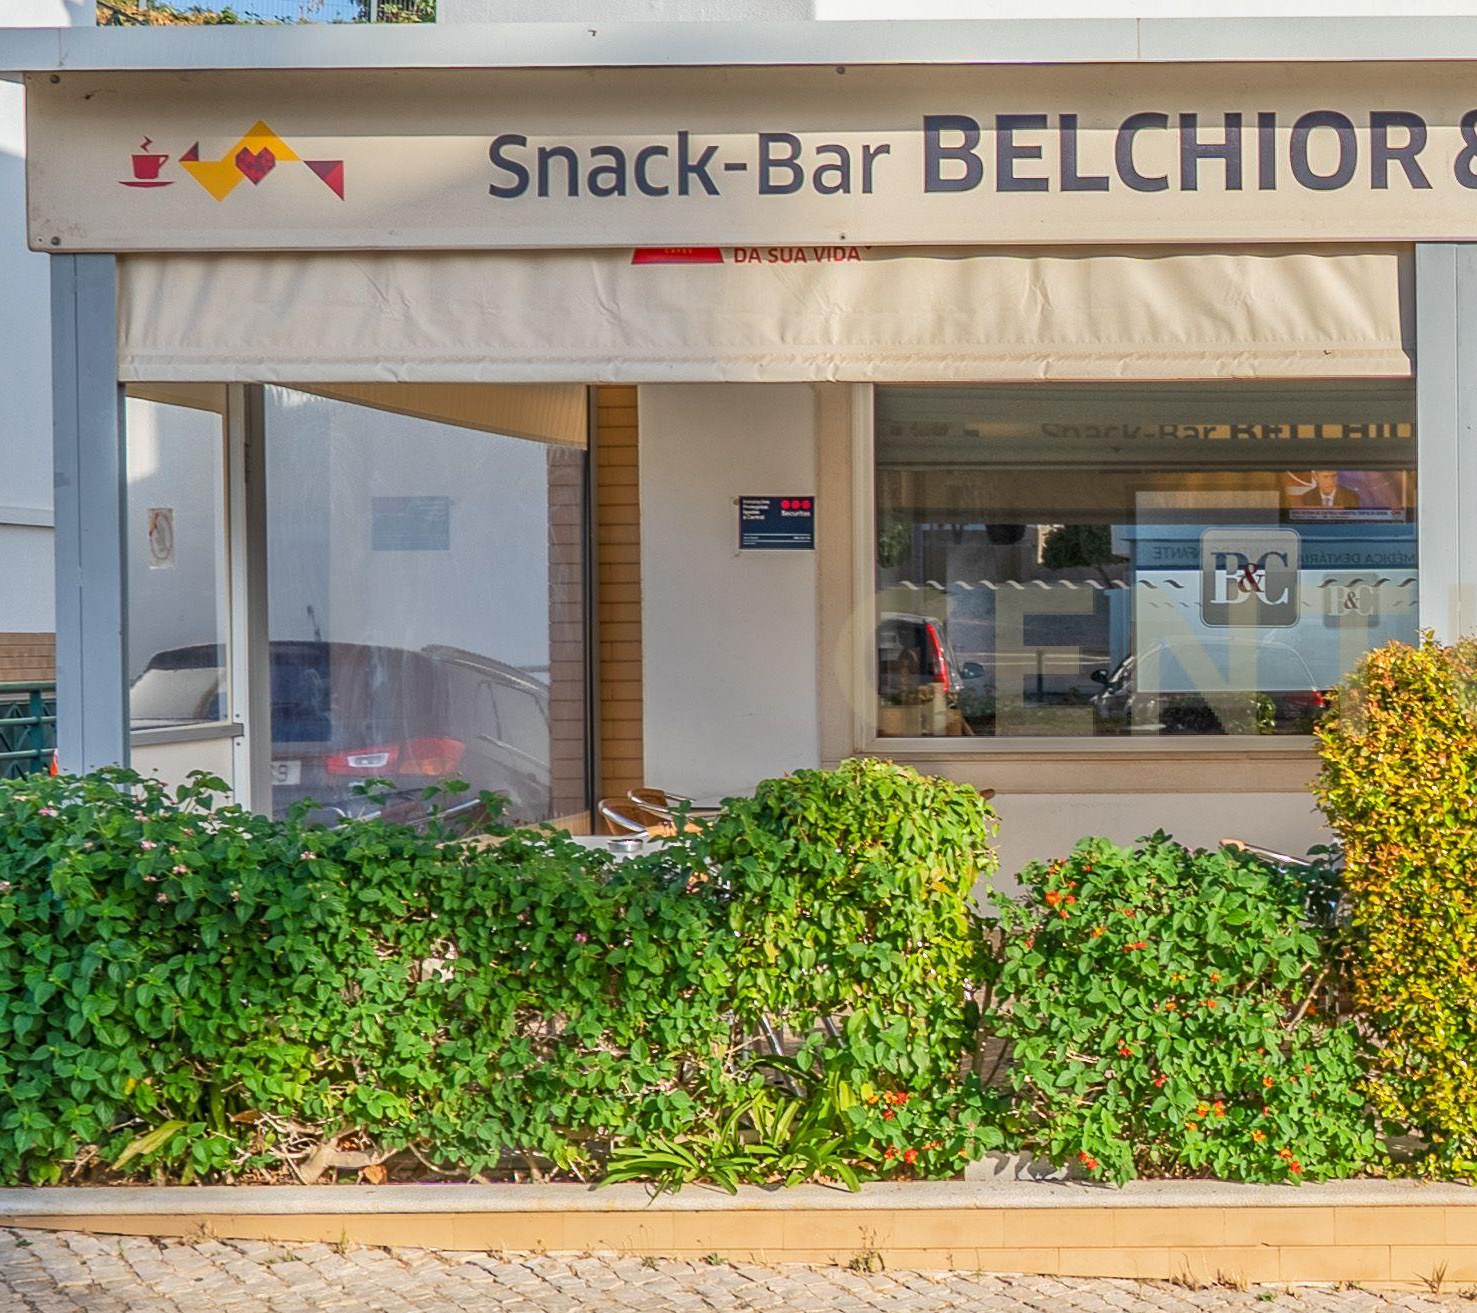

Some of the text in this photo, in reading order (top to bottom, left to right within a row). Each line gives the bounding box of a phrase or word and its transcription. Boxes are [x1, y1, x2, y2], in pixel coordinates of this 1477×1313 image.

[488, 130, 891, 199] Snack-Bar
[922, 110, 1433, 193] BELCHIOR
[733, 246, 862, 264] DA SUA VIDA
[1210, 550, 1291, 607] B&C
